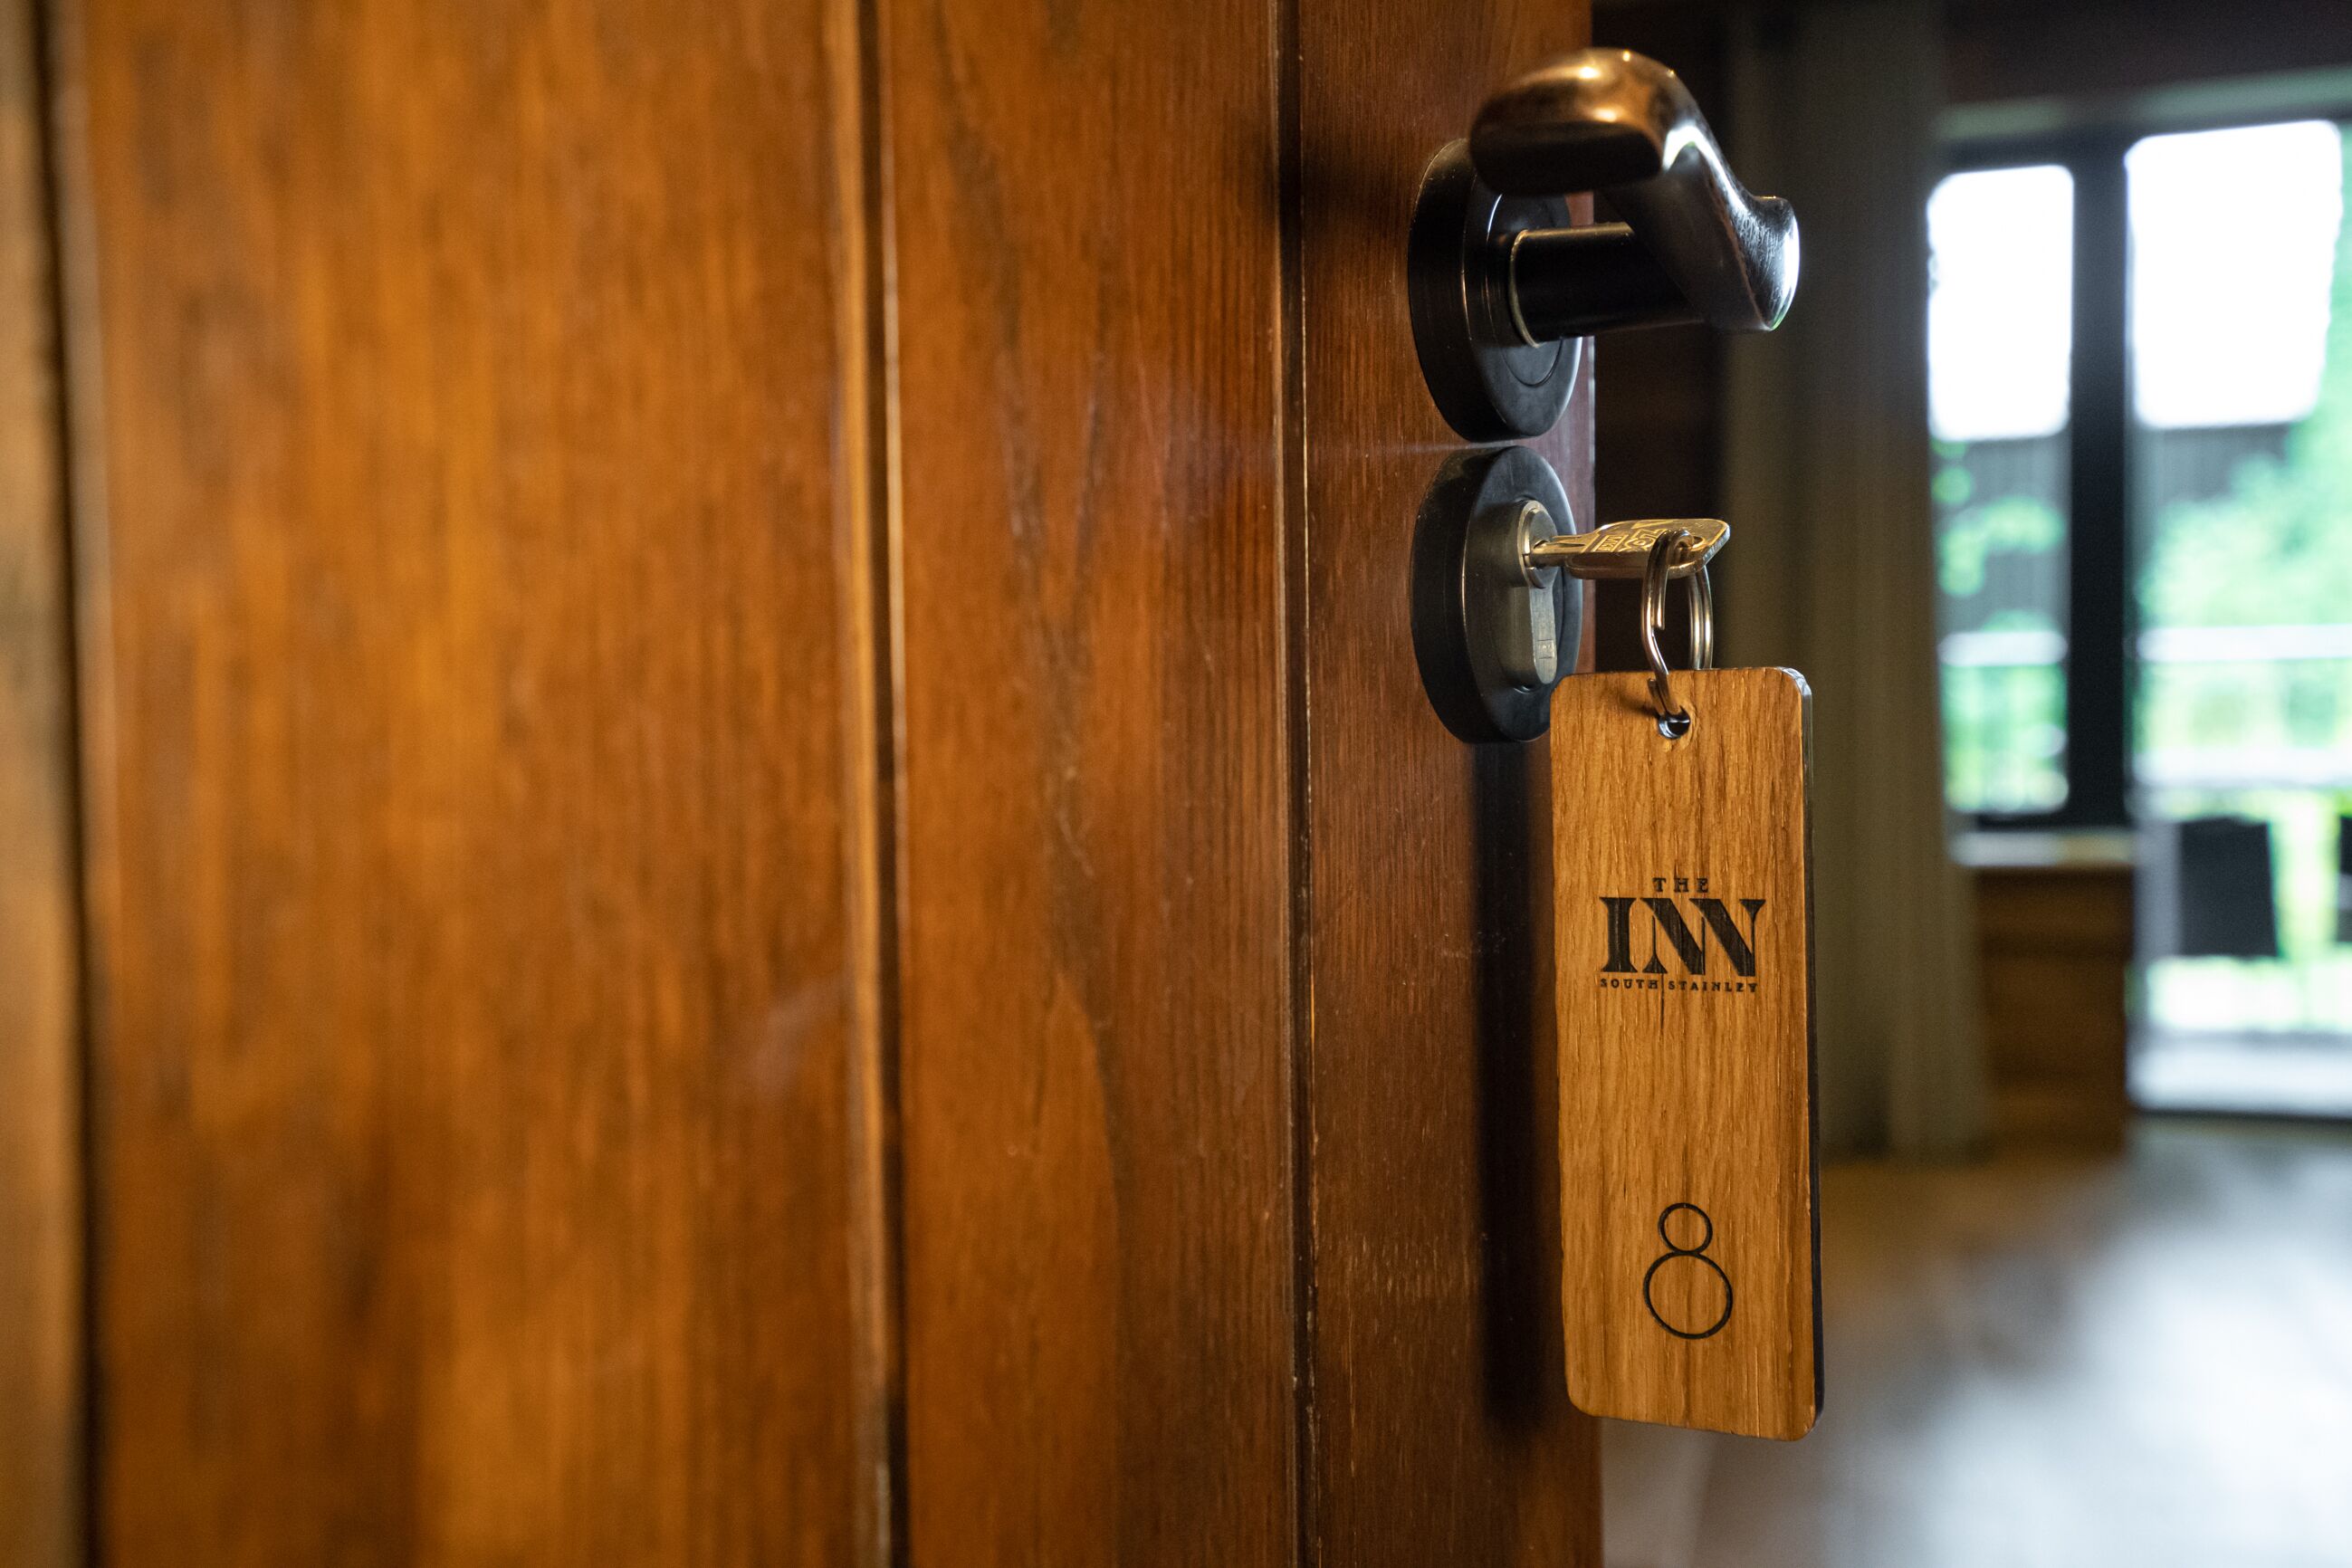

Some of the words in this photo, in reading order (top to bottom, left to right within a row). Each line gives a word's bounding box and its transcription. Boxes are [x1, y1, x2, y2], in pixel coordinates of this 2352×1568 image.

[1652, 876, 1709, 894] THE
[1599, 896, 1766, 977] INN
[1600, 978, 1659, 990] SOUTH
[1668, 980, 1758, 993] STAINLEY
[1642, 1202, 1734, 1341] 8
